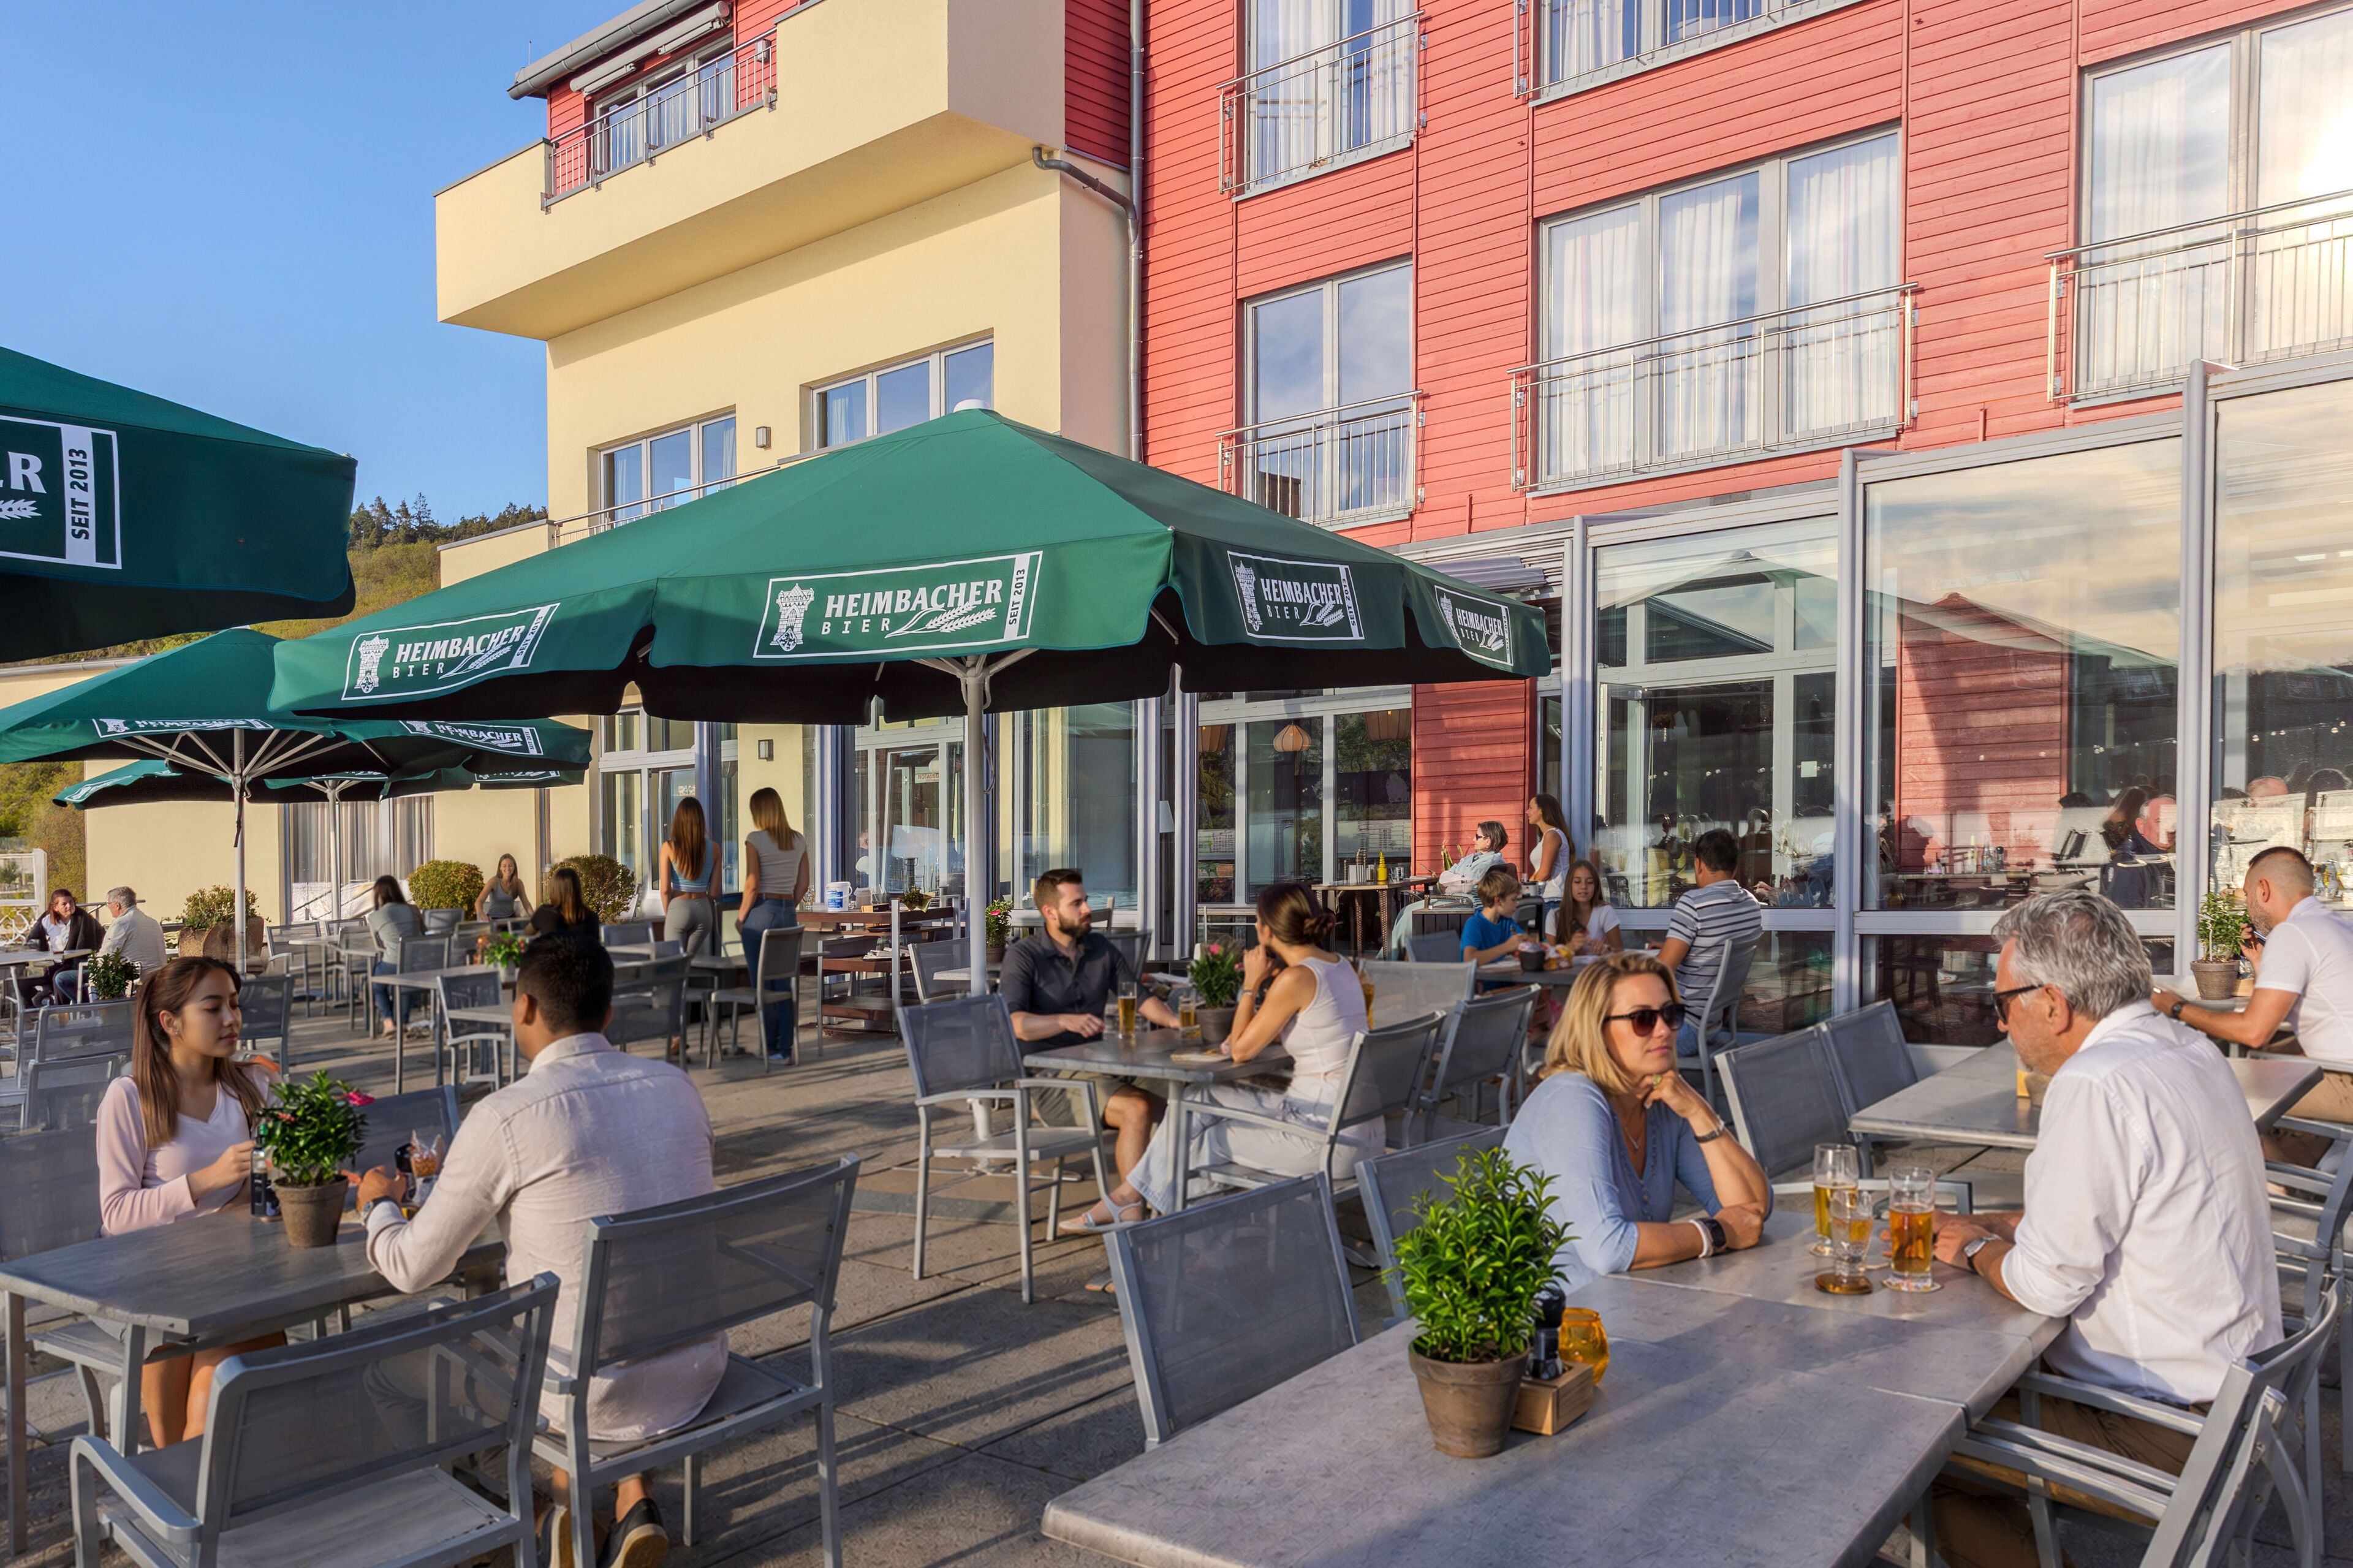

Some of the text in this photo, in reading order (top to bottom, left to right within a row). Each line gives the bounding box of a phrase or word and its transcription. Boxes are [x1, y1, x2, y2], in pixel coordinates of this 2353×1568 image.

[0, 451, 47, 494] R
[68, 448, 89, 540] SEIT 2013
[824, 579, 1003, 618] HEIMBACHER
[1009, 569, 1025, 626] SEIT 2013
[1260, 578, 1344, 605] HEIMBACHER
[1266, 604, 1300, 619] BIER
[1347, 605, 1356, 626] SEIT
[1455, 608, 1504, 636] HEIMBACHER
[821, 618, 890, 635] BIER
[395, 625, 525, 663] HEIMBACHER
[517, 638, 531, 657] SEIT
[393, 662, 444, 679] BIER
